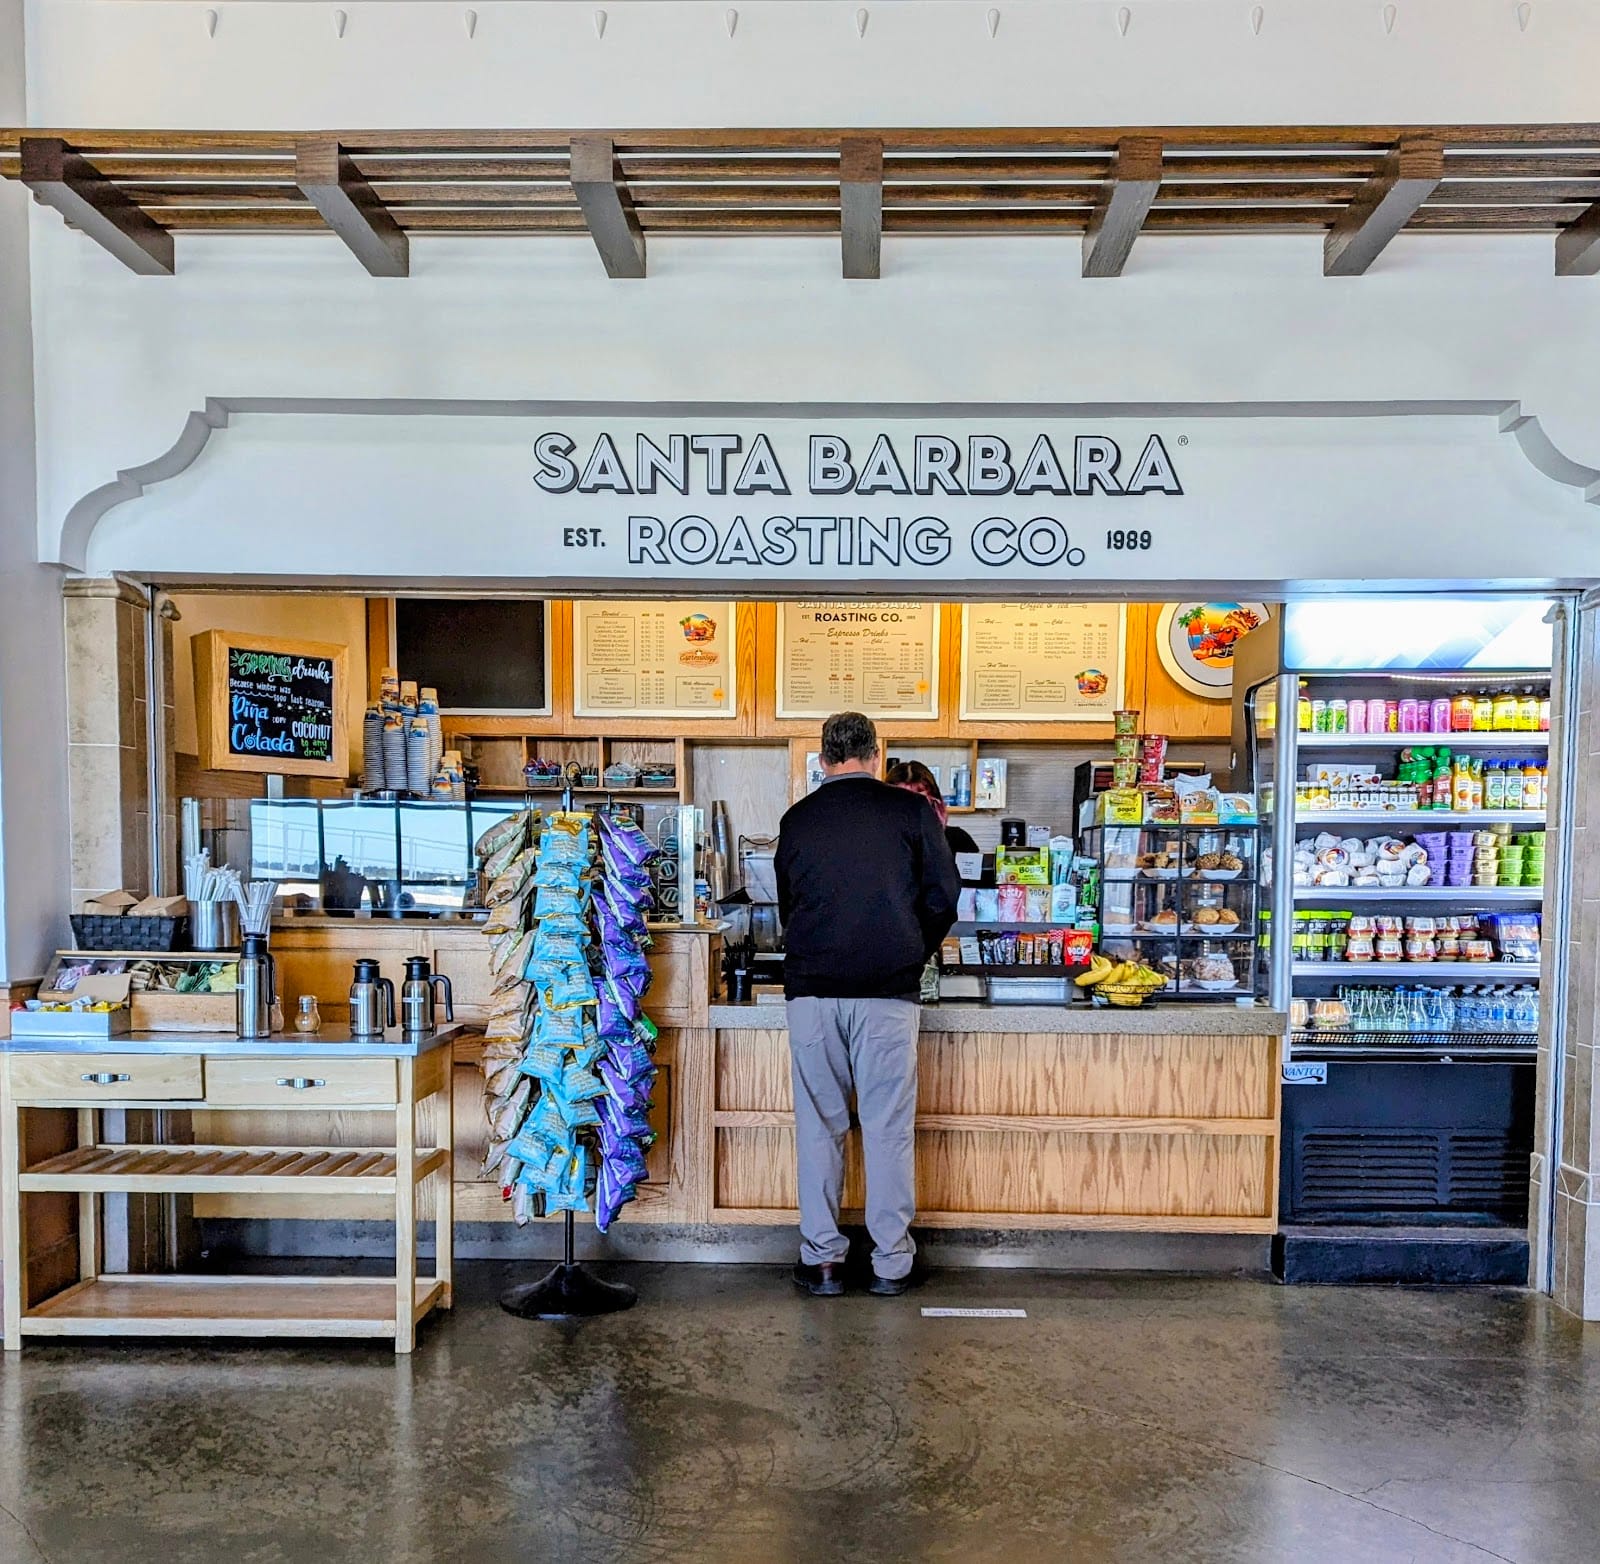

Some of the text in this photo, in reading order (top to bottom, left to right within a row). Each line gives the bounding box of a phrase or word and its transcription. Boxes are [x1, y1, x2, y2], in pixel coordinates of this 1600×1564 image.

[532, 433, 1184, 495] SANTA BARBARA
[563, 516, 1152, 567] EST. ROASTING CO. 1989
[815, 612, 877, 622] ROASTING
[881, 613, 903, 622] CO.
[827, 627, 889, 638] Espresso Drinks
[291, 658, 333, 684] drinks
[231, 694, 269, 727] Piña
[290, 694, 303, 705] last
[301, 714, 316, 723] add
[231, 723, 295, 753] Colada
[292, 721, 332, 740] COCONUT
